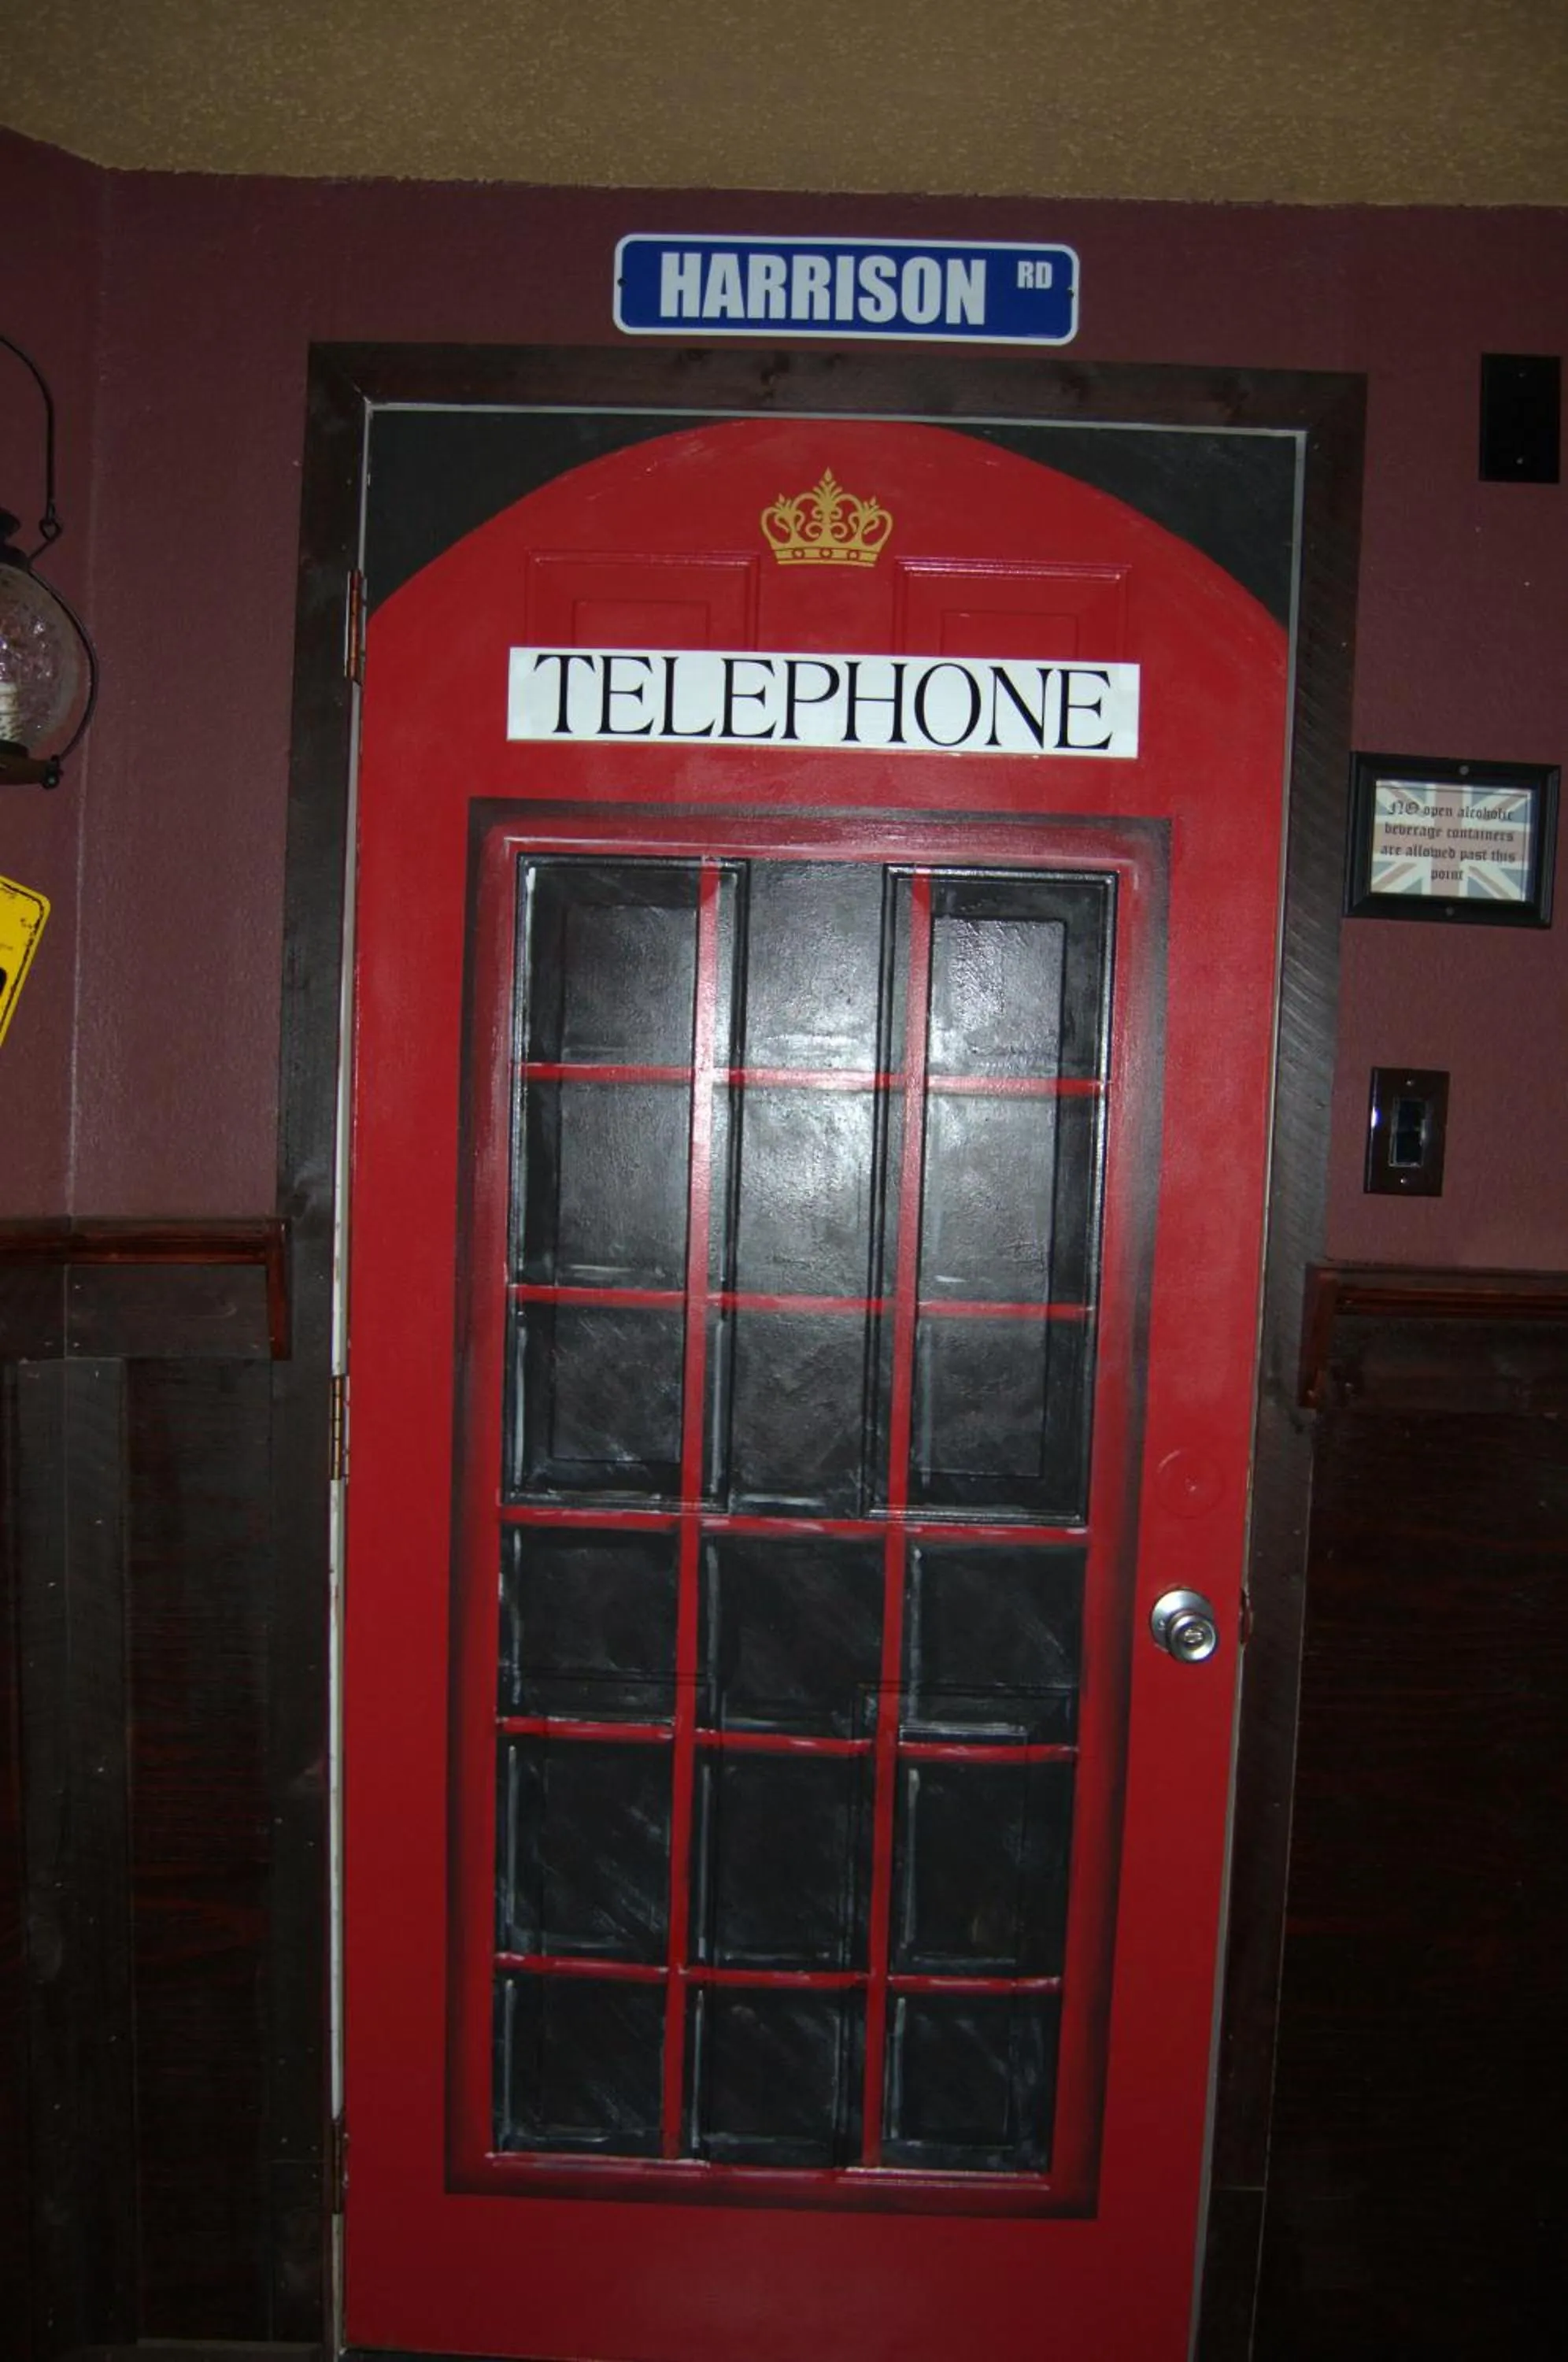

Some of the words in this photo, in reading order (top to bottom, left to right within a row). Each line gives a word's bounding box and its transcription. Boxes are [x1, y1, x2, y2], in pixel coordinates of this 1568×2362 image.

[660, 252, 986, 325] HARRISON
[1017, 261, 1052, 289] RD
[534, 654, 1113, 750] TELEPHONE
[1422, 805, 1453, 817] open
[1457, 805, 1513, 822] alcoholic
[1385, 821, 1442, 839] beverage
[1446, 827, 1514, 842] containers
[1380, 844, 1403, 856] are
[1405, 844, 1455, 859] allowed
[1459, 849, 1488, 861] past
[1490, 850, 1516, 863] this
[1430, 868, 1464, 880] point
